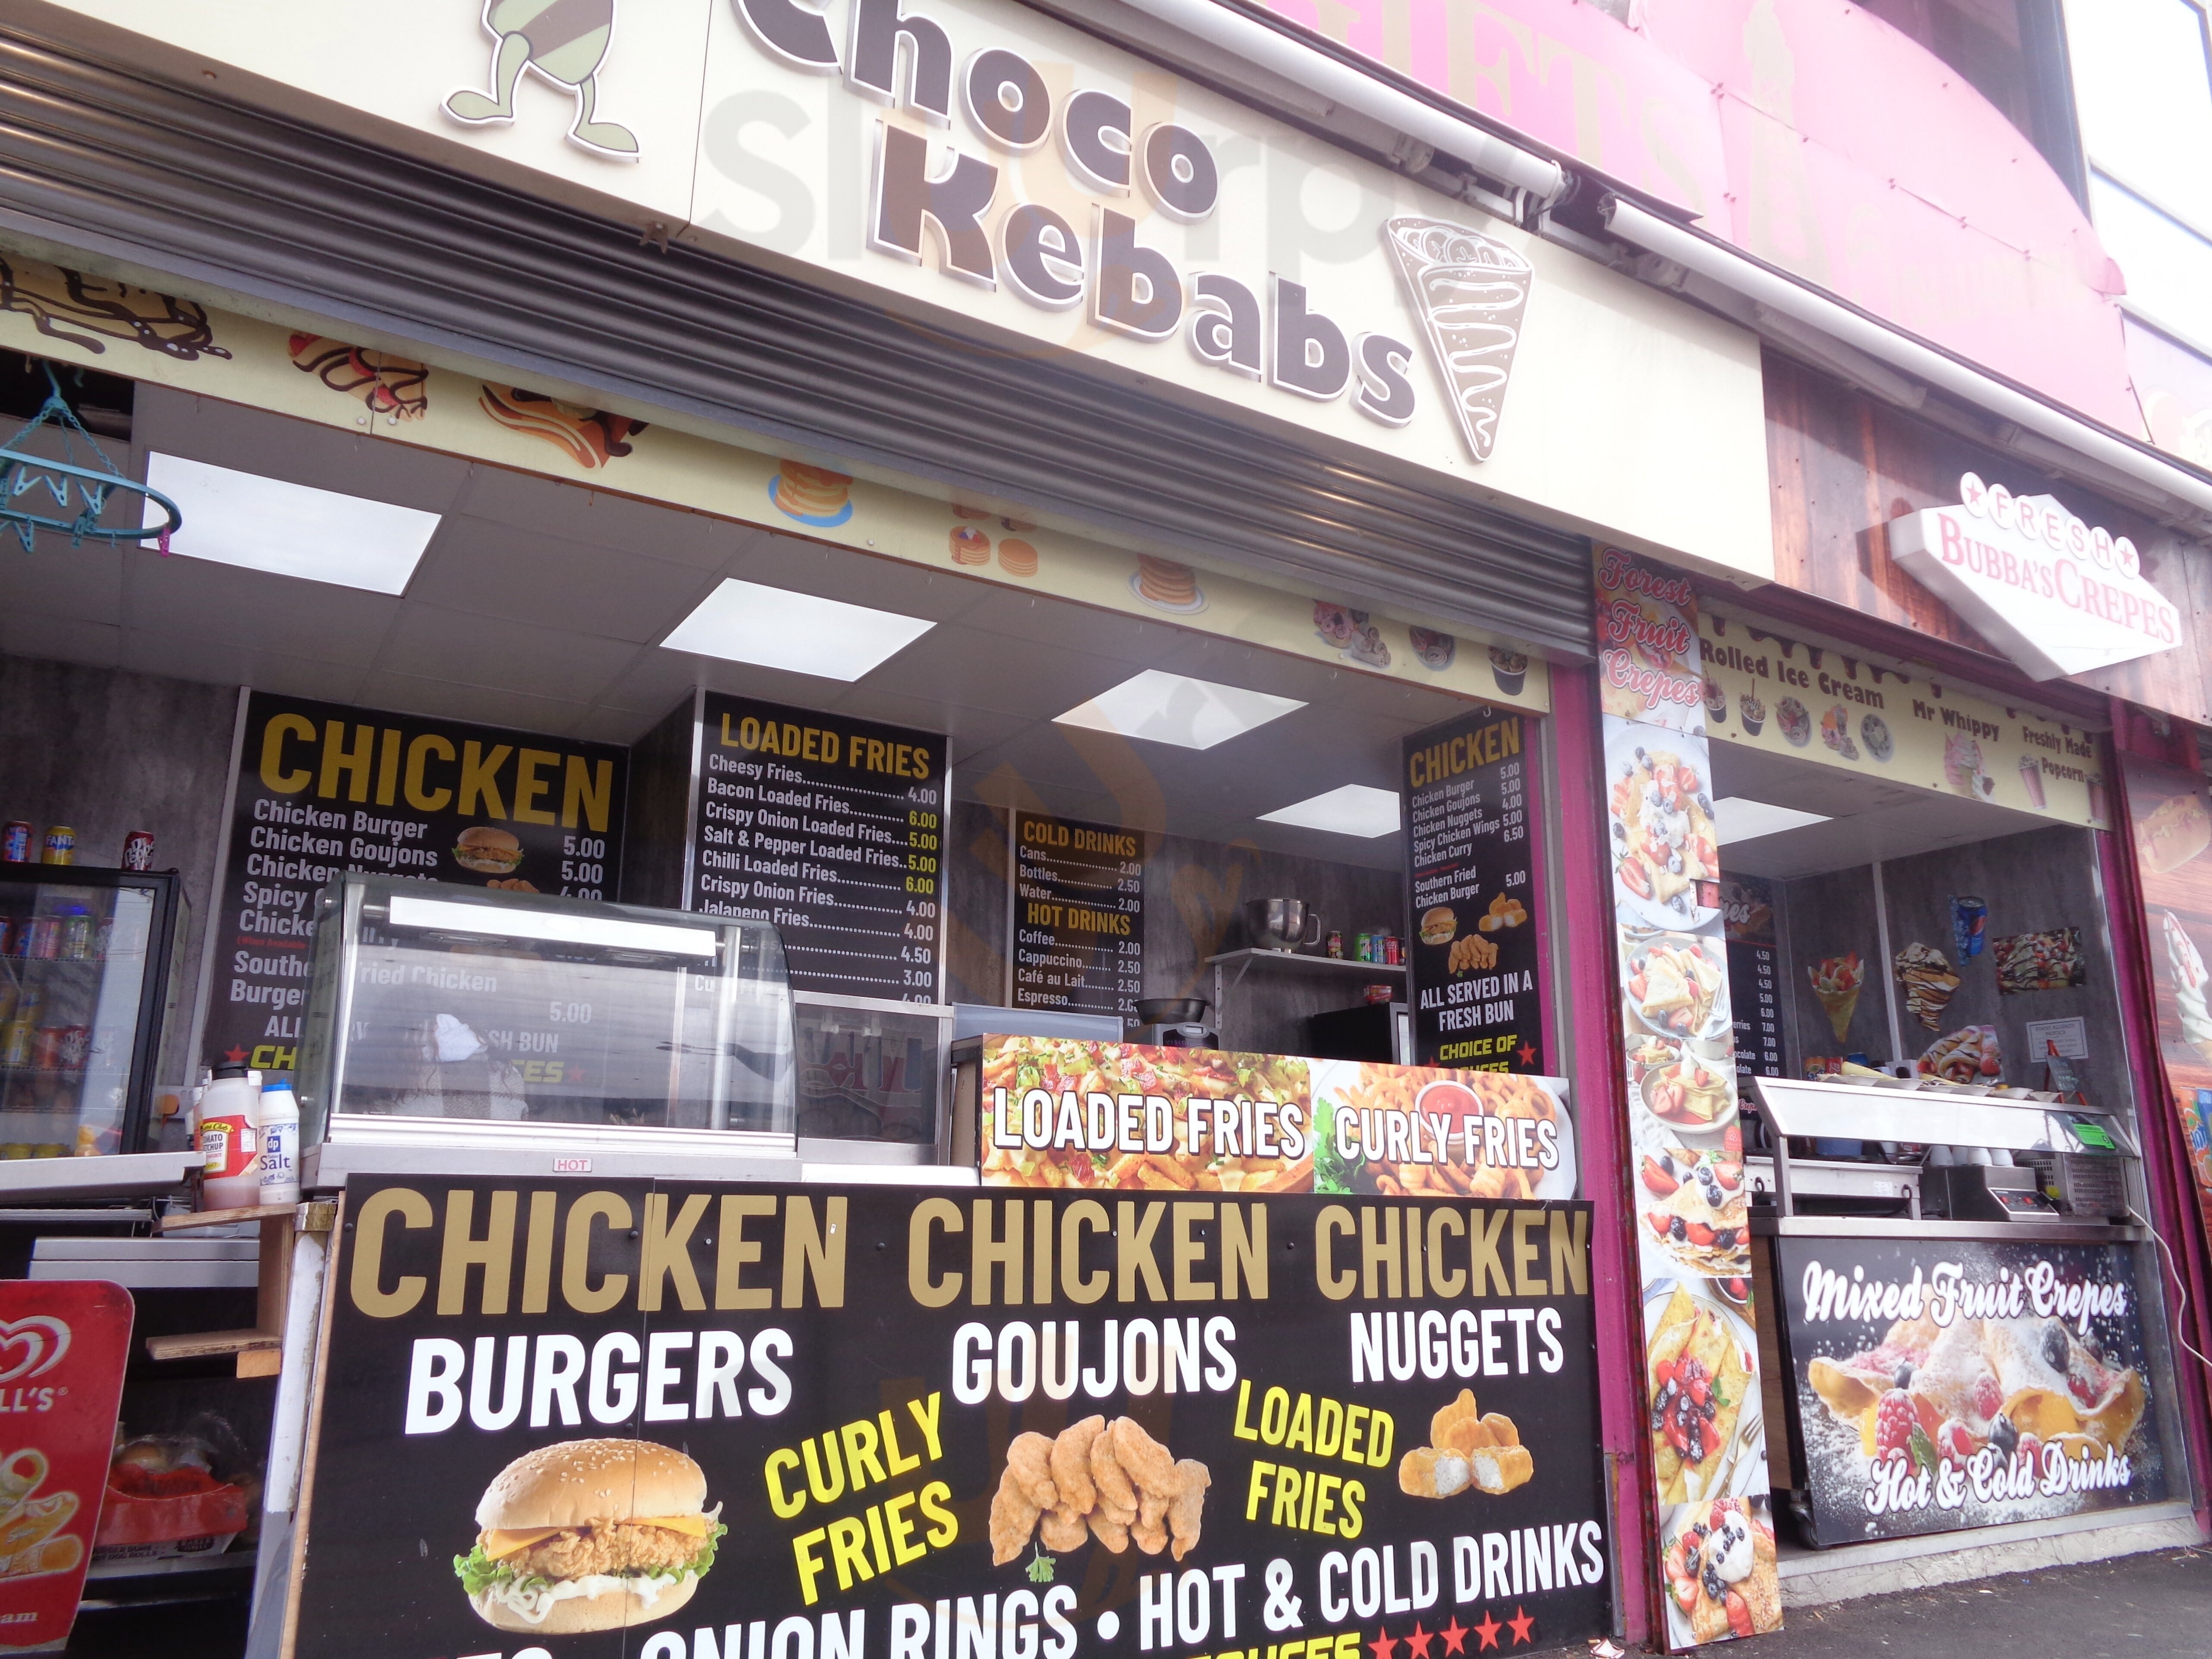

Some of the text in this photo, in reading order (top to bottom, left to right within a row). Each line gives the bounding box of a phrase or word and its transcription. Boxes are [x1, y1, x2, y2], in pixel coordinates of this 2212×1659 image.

[866, 120, 1417, 429] Kebabs
[1996, 492, 2111, 562] FRESH
[1599, 547, 1690, 605] Forest
[2056, 558, 2174, 644] CREPES
[1608, 599, 1690, 654] Fruit
[1603, 647, 1700, 709] Crepes
[1699, 637, 1884, 710] Rolled Ice Cream
[1912, 699, 1999, 742] Mr Whippy
[2023, 726, 2092, 759] Freshly Made
[721, 713, 929, 779] LOADED FRIES
[1410, 716, 1520, 788] CHICKEN
[260, 713, 613, 833] CHICKEN
[710, 754, 763, 780] Cheesy
[908, 787, 937, 804] 4.00
[1412, 762, 1520, 808] Chicken Burger 5.00
[2041, 757, 2084, 783] Popcorn
[708, 777, 754, 799] Bacon
[759, 786, 811, 809] Loaded
[909, 811, 937, 828] 6.00
[1413, 778, 1521, 823] Chicken Goujons 5.00
[1414, 794, 1522, 838] Chicken Nuggets 4.00
[254, 798, 605, 859] Chicken Burger 5.00
[706, 801, 753, 826] Crispy
[758, 808, 798, 830] Onion
[803, 815, 854, 838] Loaded
[909, 833, 937, 850] 5.00
[1024, 821, 1136, 857] COLD DRINKS
[1414, 810, 1522, 855] Spicy Chicken Wings 5.00
[1414, 826, 1524, 867] Chicken Curry 6.50
[250, 826, 603, 884] Chicken Goujons 5.00
[703, 849, 740, 869] Chilli
[745, 857, 798, 878] Loaded
[905, 877, 934, 894] 6.00
[704, 825, 733, 845] Salt
[738, 830, 749, 846] &
[755, 833, 806, 855] Pepper
[811, 840, 861, 863] Loaded
[908, 857, 936, 873] 5.00
[1120, 861, 1141, 876] 2.00
[243, 881, 308, 913] Spicy
[701, 873, 749, 899] Crispy
[753, 880, 794, 901] Onion
[906, 900, 936, 918] 4.00
[1118, 878, 1140, 893] 2.50
[1415, 873, 1452, 893] Southern
[1455, 865, 1476, 883] Fried
[1506, 870, 1526, 887] 5.00
[1416, 883, 1479, 909] Chicken Burger
[1027, 903, 1130, 935] HOT DRINKS
[1119, 898, 1140, 913] 2.00
[904, 924, 933, 941] 4.00
[1119, 941, 1141, 955] 2.00
[901, 946, 931, 965] 4.50
[1118, 960, 1141, 974] 2.50
[1756, 950, 1770, 961] 4.50
[1758, 965, 1771, 975] 4.50
[903, 969, 932, 988] 3.00
[1018, 968, 1043, 983] Café
[1047, 974, 1061, 985] au
[1118, 979, 1141, 993] 2.50
[1420, 970, 1533, 1009] ALL SERVED IN A
[1759, 979, 1772, 990] 4.50
[1760, 993, 1772, 1004] 5.00
[549, 1001, 592, 1024] 5.00
[1439, 1000, 1514, 1031] FRESH BUN
[1761, 1008, 1774, 1018] 6.00
[1762, 1022, 1775, 1033] 7.00
[1440, 1034, 1517, 1061] CHOICE OF
[1763, 1037, 1776, 1047] 7.00
[1765, 1051, 1778, 1062] 6.00
[1766, 1066, 1778, 1077] 6.00
[268, 1137, 279, 1151] dp
[993, 1087, 1305, 1159] LOADED FRIES
[1336, 1106, 1558, 1170] CURLY FRIES
[261, 1153, 290, 1171] Salt
[558, 1160, 588, 1170] HOT
[350, 1187, 848, 1318] CHICKEN
[908, 1198, 1269, 1308] CHICKEN
[1315, 1204, 1588, 1301] CHICKEN
[1802, 1260, 2127, 1336] Mixed Fruit Crepes
[951, 1315, 1237, 1405] GOUJONS
[1351, 1307, 1564, 1383] NUGGETS
[404, 1328, 794, 1435] BURGERS
[1233, 1379, 1394, 1469] LOADED
[764, 1391, 944, 1520] CURLY
[1864, 1440, 2131, 1516] Hot & Cold Drinks
[1245, 1460, 1366, 1540] FRIES
[792, 1480, 958, 1606] FRIES
[889, 1585, 1078, 1659] RINGS
[1139, 1563, 1245, 1651] HOT
[1263, 1557, 1304, 1632] &
[1319, 1540, 1439, 1623] COLD
[1453, 1520, 1604, 1605] DRINKS
